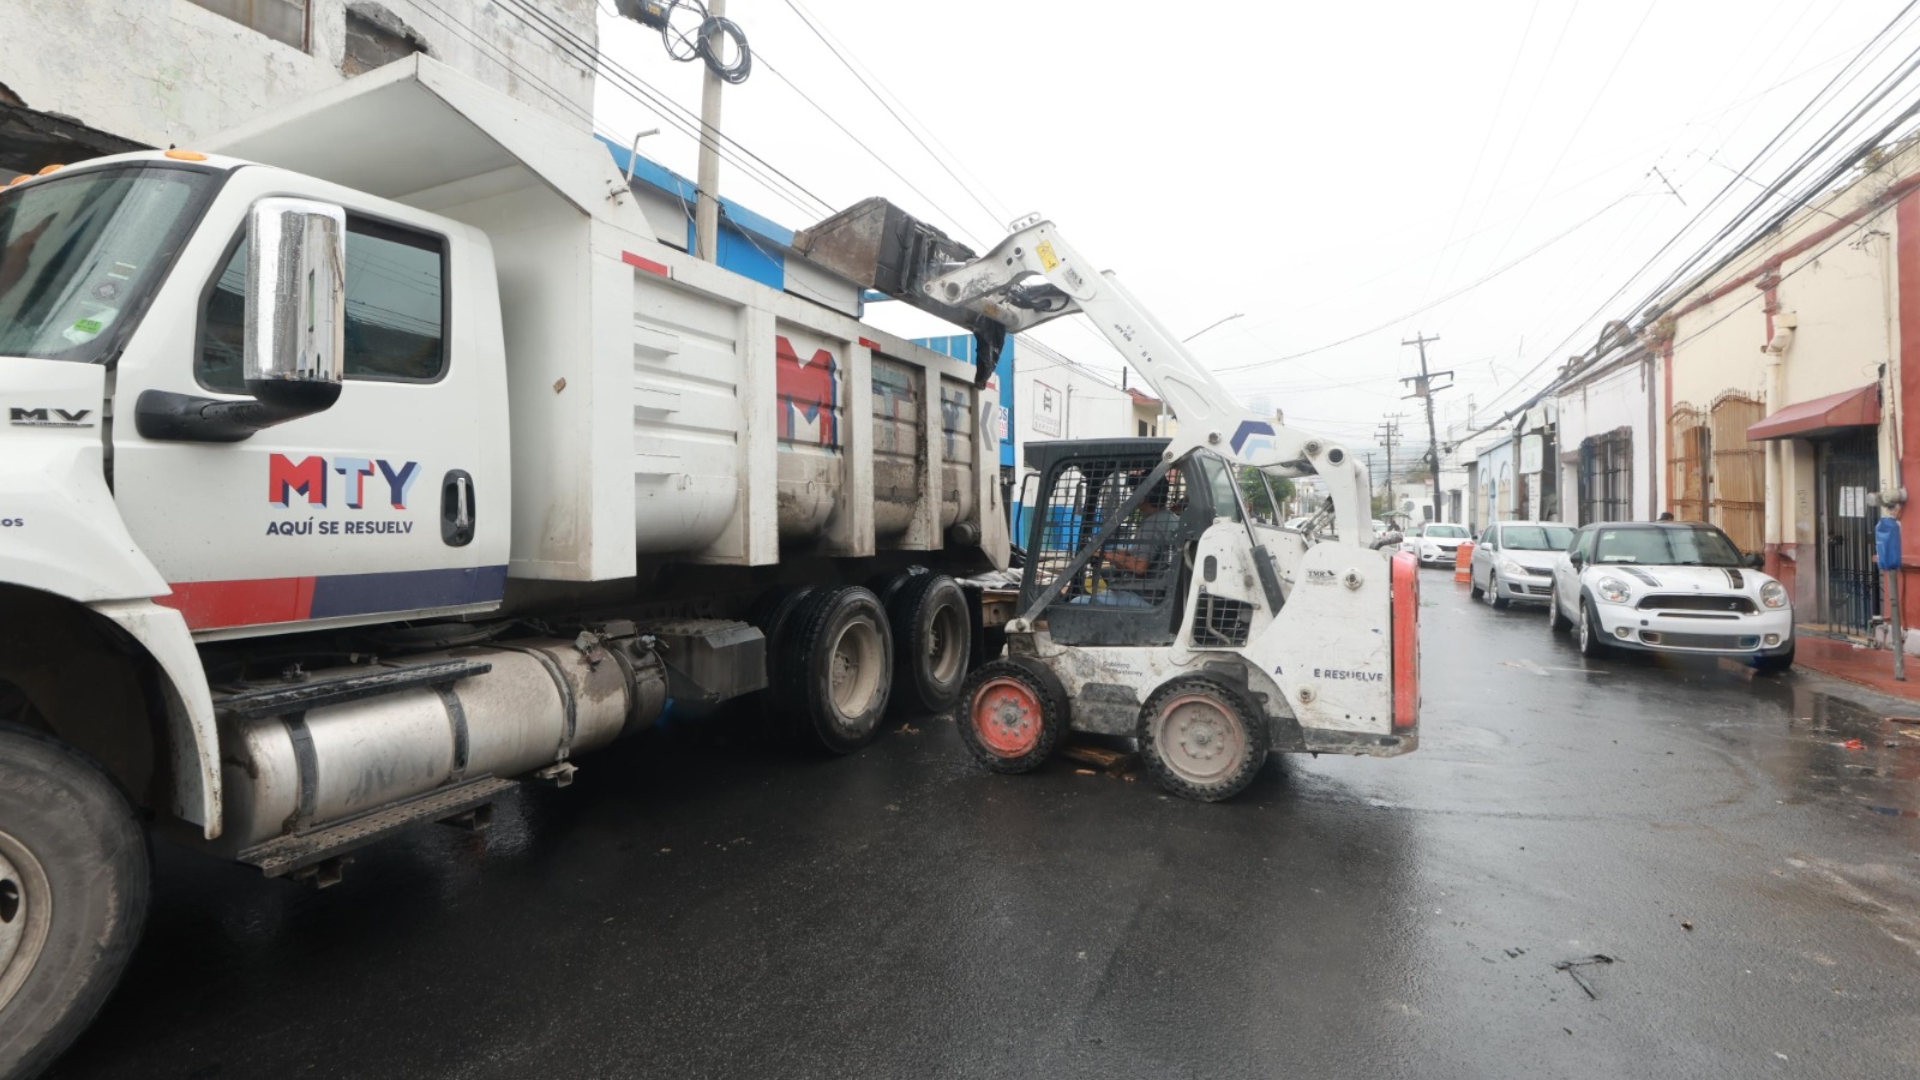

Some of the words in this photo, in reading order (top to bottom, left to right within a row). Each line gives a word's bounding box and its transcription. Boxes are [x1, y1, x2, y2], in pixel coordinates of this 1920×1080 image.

[10, 407, 92, 421] MV
[269, 453, 422, 510] MTY
[266, 516, 314, 536] AQUÍ
[318, 521, 340, 535] SE
[344, 520, 414, 534] RESUELV
